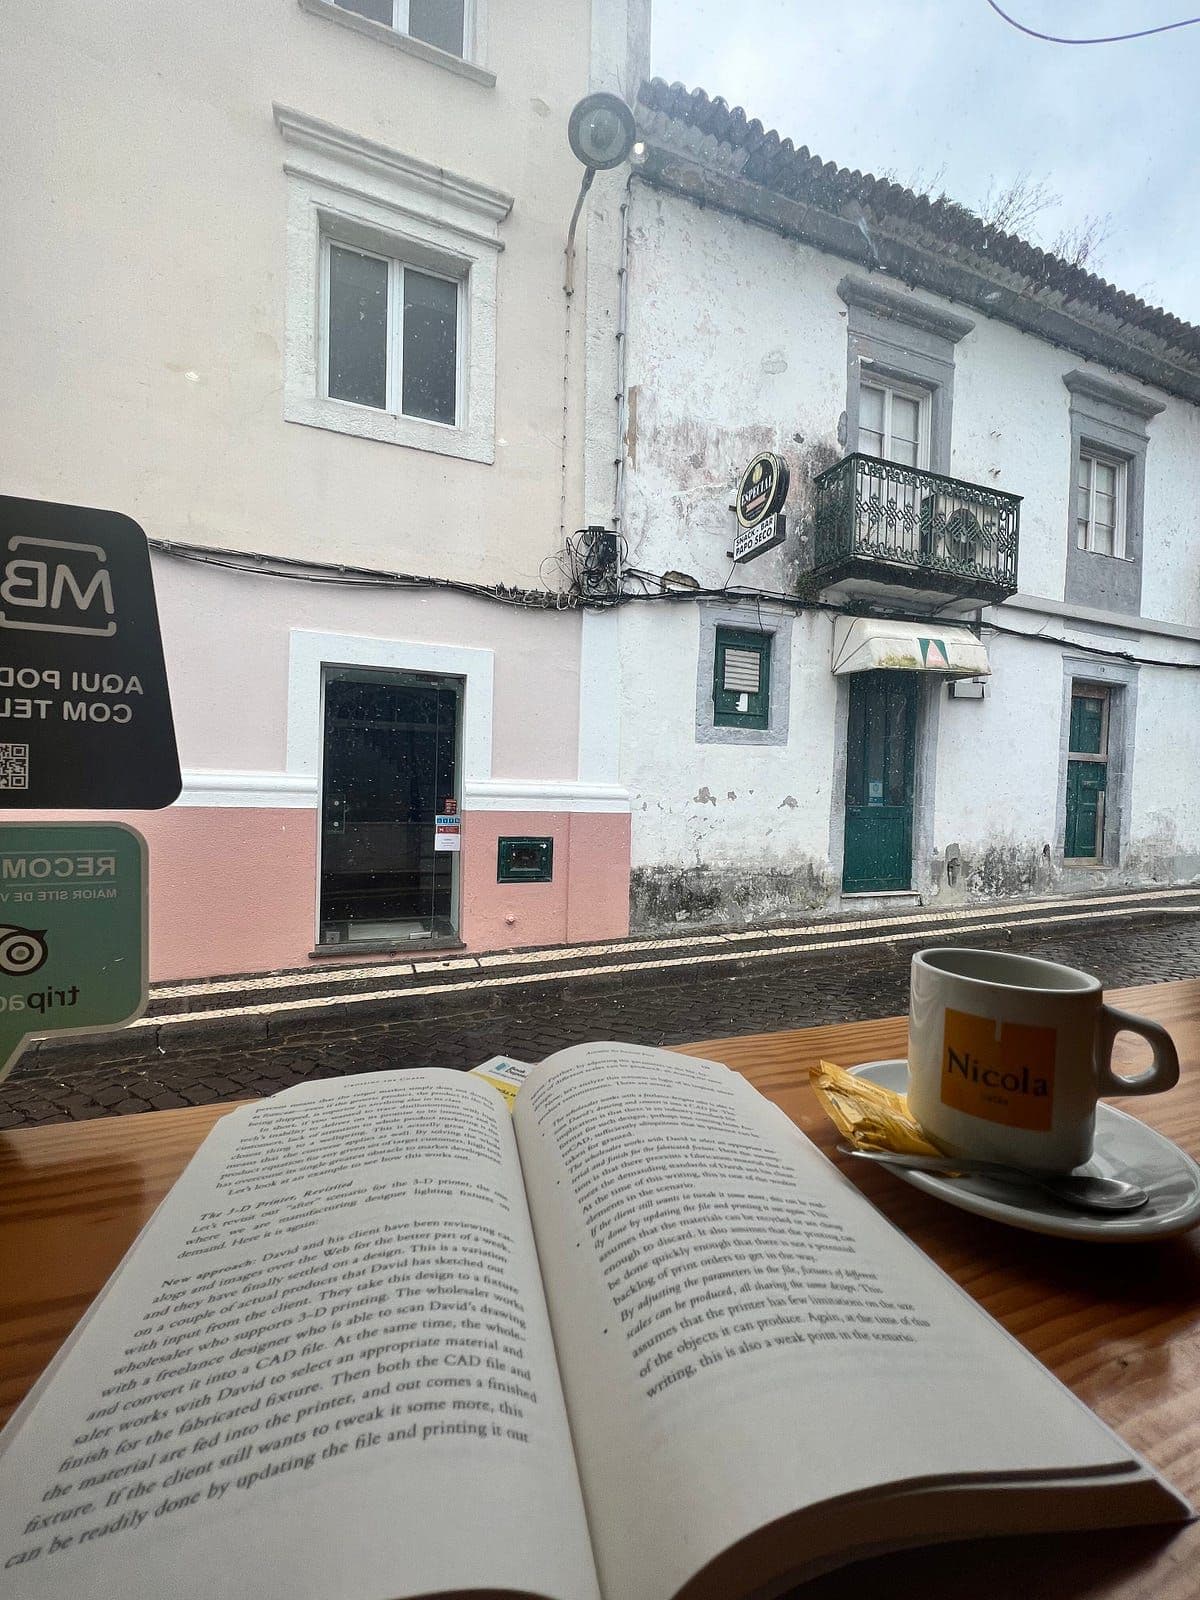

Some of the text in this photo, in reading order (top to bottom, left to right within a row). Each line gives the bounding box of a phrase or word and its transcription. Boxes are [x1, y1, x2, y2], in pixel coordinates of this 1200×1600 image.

[736, 528, 755, 546] SNACK
[736, 527, 772, 556] PAPO SECO
[947, 1047, 1049, 1097] Nicola
[304, 1181, 353, 1197] Revisited
[102, 1382, 137, 1398] with
[142, 1377, 150, 1386] a
[156, 1356, 224, 1382] freelance
[230, 1335, 291, 1360] designer
[296, 1324, 326, 1341] who
[332, 1321, 341, 1330] is
[347, 1309, 373, 1326] able
[379, 1307, 392, 1317] to
[397, 1304, 424, 1314] scan
[480, 1305, 526, 1329] drawing
[114, 1347, 193, 1375] wholesaler
[199, 1337, 229, 1351] who
[235, 1319, 293, 1340] supports
[331, 1294, 390, 1315] printing.
[396, 1288, 421, 1297] The
[427, 1286, 489, 1298] wholesaler
[494, 1292, 524, 1312] works
[125, 1341, 157, 1355] with
[163, 1330, 201, 1347] input
[205, 1319, 239, 1333] from
[245, 1310, 266, 1322] the
[271, 1298, 313, 1314] client.
[320, 1287, 351, 1301] They
[357, 1278, 383, 1291] take
[388, 1275, 411, 1283] this
[415, 1272, 453, 1283] design
[458, 1272, 470, 1280] to
[632, 1326, 678, 1358] assumes
[680, 1315, 703, 1328] that
[706, 1306, 725, 1318] the
[728, 1299, 766, 1316] printer
[767, 1296, 786, 1306] has
[788, 1295, 807, 1304] few
[640, 1361, 651, 1377] of
[655, 1351, 673, 1366] the
[677, 1330, 719, 1353] objects
[721, 1326, 730, 1336] it
[734, 1321, 753, 1333] can
[757, 1315, 804, 1330] produce.
[74, 1337, 523, 1446] saler works with David to select an appropriate material and
[86, 1402, 119, 1422] and
[123, 1385, 185, 1411] convert
[190, 1380, 201, 1391] it
[206, 1369, 237, 1386] into
[242, 1366, 249, 1374] a
[255, 1350, 297, 1371] CAD
[301, 1342, 328, 1357] file.
[334, 1336, 351, 1347] At
[356, 1328, 378, 1340] the
[383, 1321, 417, 1335] same
[423, 1320, 456, 1329] time,
[461, 1319, 481, 1329] the
[647, 1366, 697, 1397] writing,
[700, 1351, 723, 1367] this
[726, 1346, 736, 1357] is
[740, 1338, 762, 1354] also
[765, 1339, 771, 1348] a
[774, 1332, 805, 1344] weak
[807, 1332, 836, 1343] point
[839, 1331, 851, 1339] in
[853, 1330, 870, 1340] the
[42, 1377, 537, 1501] the material are fed into the printer, and out comes a finished
[59, 1354, 531, 1472] finish for the fabricated fixture. Then both the CAD file and
[5, 1421, 529, 1568] can be readily done by updating the file and printing it out
[24, 1399, 523, 1534] fixture. If the client still wants to tweak it some more, this
